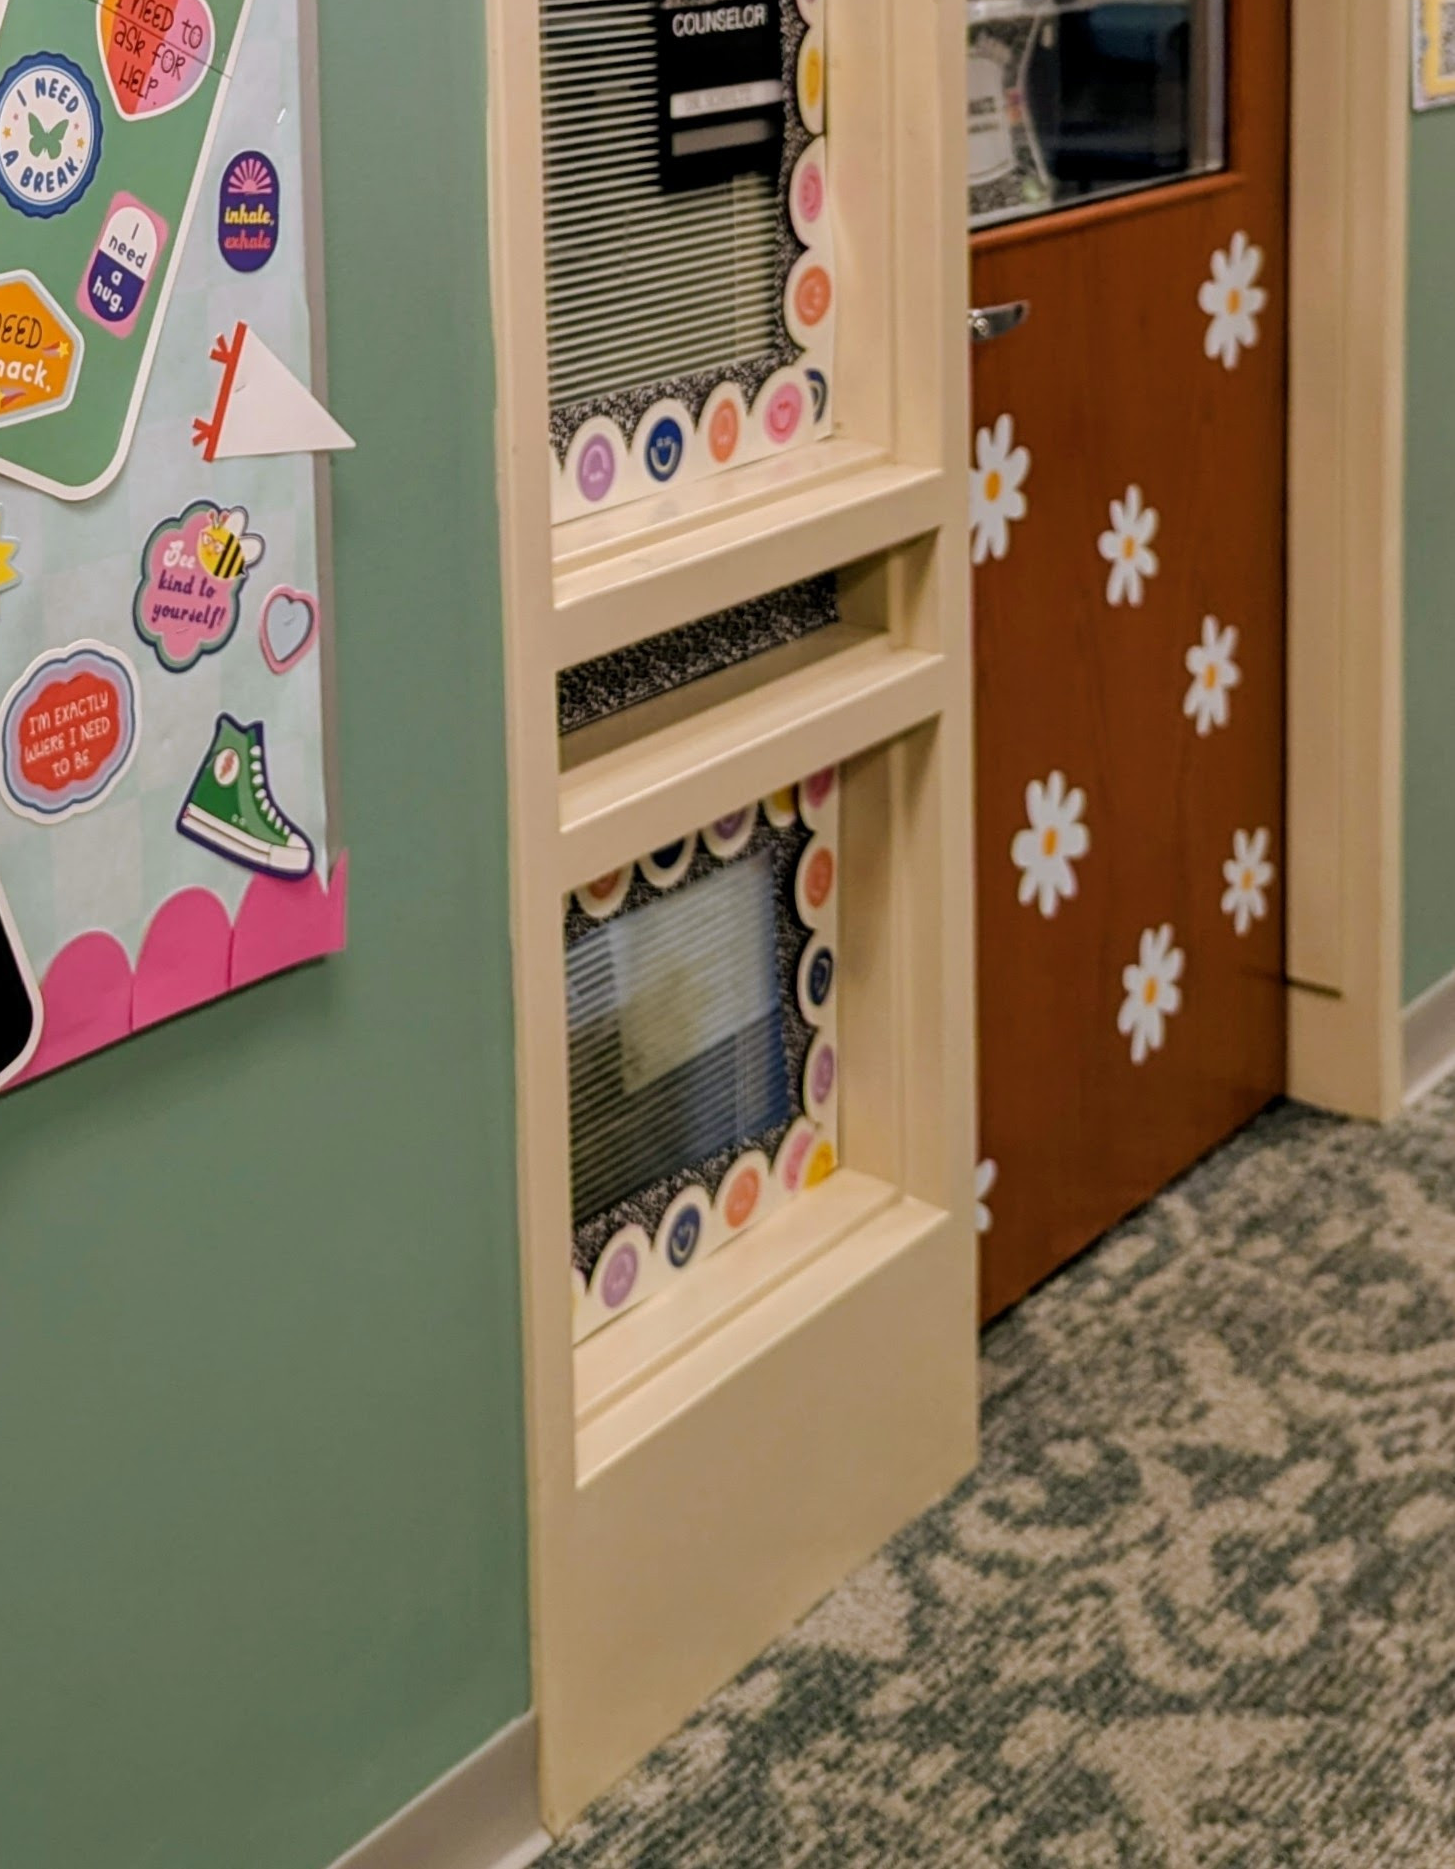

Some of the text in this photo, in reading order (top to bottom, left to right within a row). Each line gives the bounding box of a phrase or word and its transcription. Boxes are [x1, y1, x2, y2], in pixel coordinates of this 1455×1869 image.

[671, 3, 768, 38] COUNSELOR
[16, 77, 79, 113] I NEED
[3, 150, 19, 167] A
[131, 223, 140, 241] I
[108, 235, 148, 269] need
[111, 270, 123, 287] a
[92, 275, 124, 313] hug.
[163, 540, 196, 569] Bee
[158, 569, 216, 599] kind to
[151, 603, 226, 630] yourself!
[29, 690, 109, 736] I'M EXACTLY
[25, 716, 111, 764] WHERE I NEED
[51, 757, 70, 778] TO
